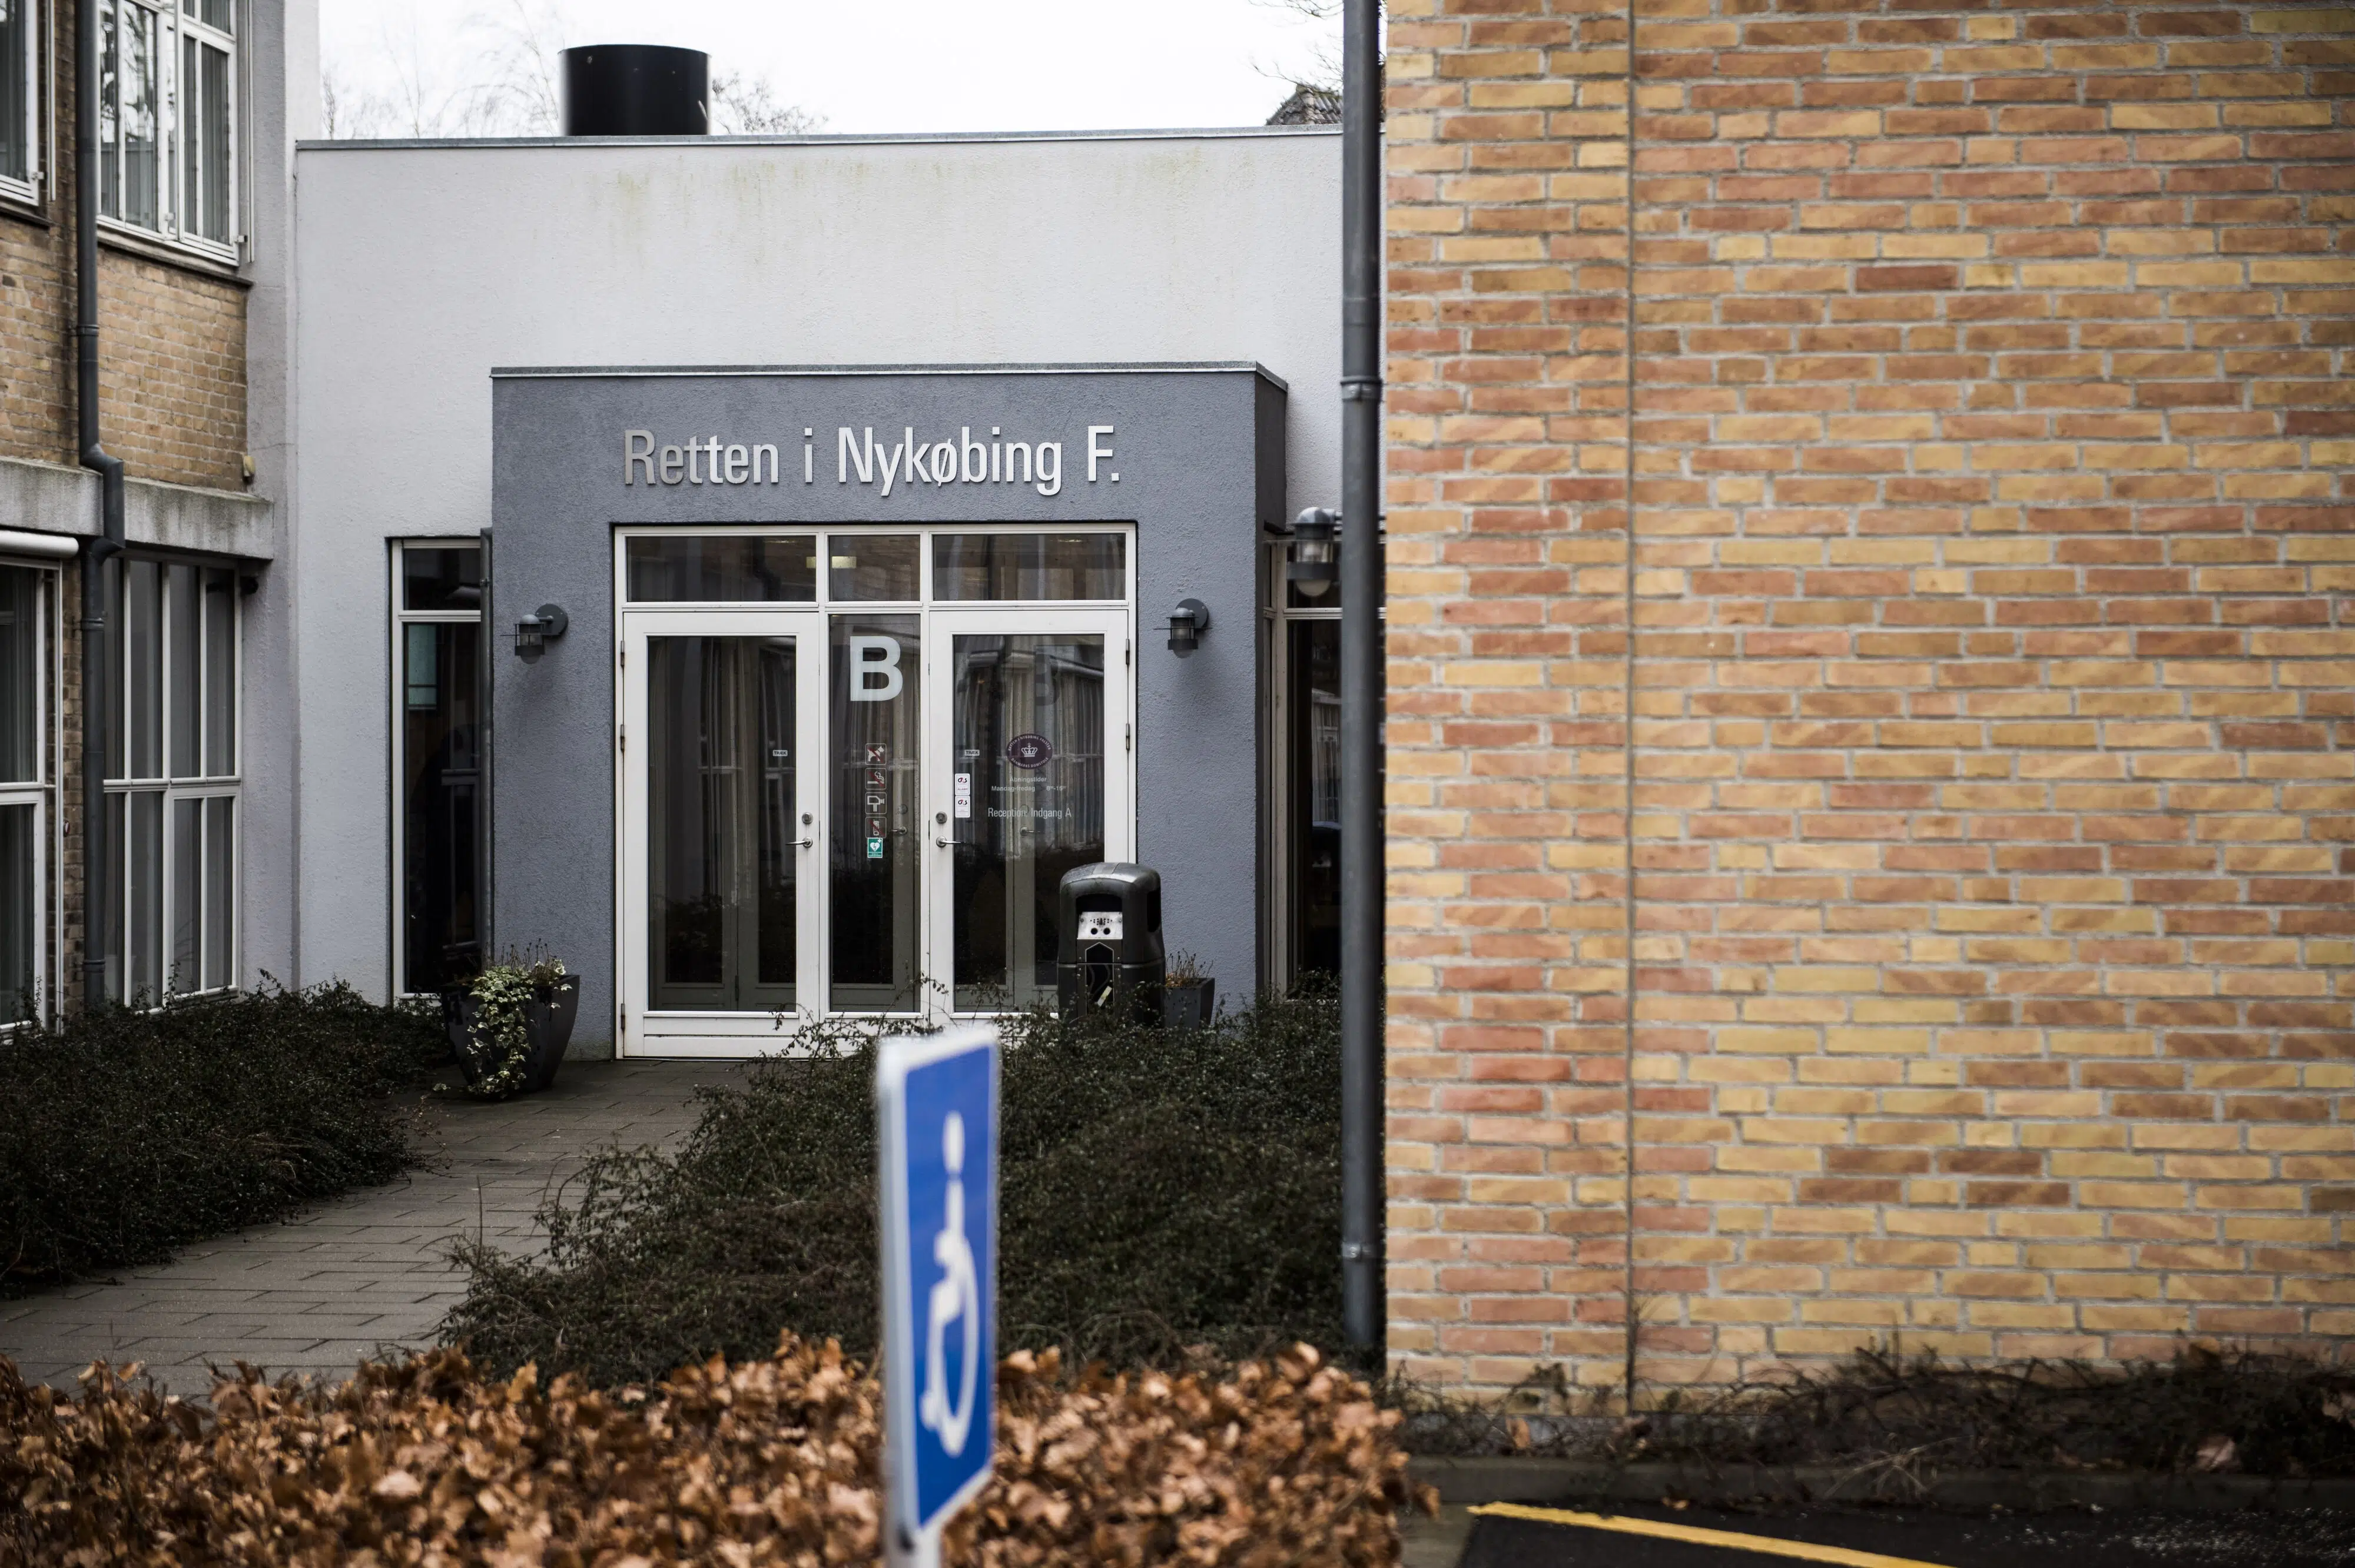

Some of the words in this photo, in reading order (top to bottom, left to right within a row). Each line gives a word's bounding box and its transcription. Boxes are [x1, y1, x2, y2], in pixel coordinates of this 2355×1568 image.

[624, 429, 779, 485] Retten
[804, 427, 813, 483] i
[838, 426, 1062, 496] Nykøbing
[1088, 425, 1119, 482] F.
[850, 636, 903, 702] B
[1031, 808, 1062, 819] Indgang
